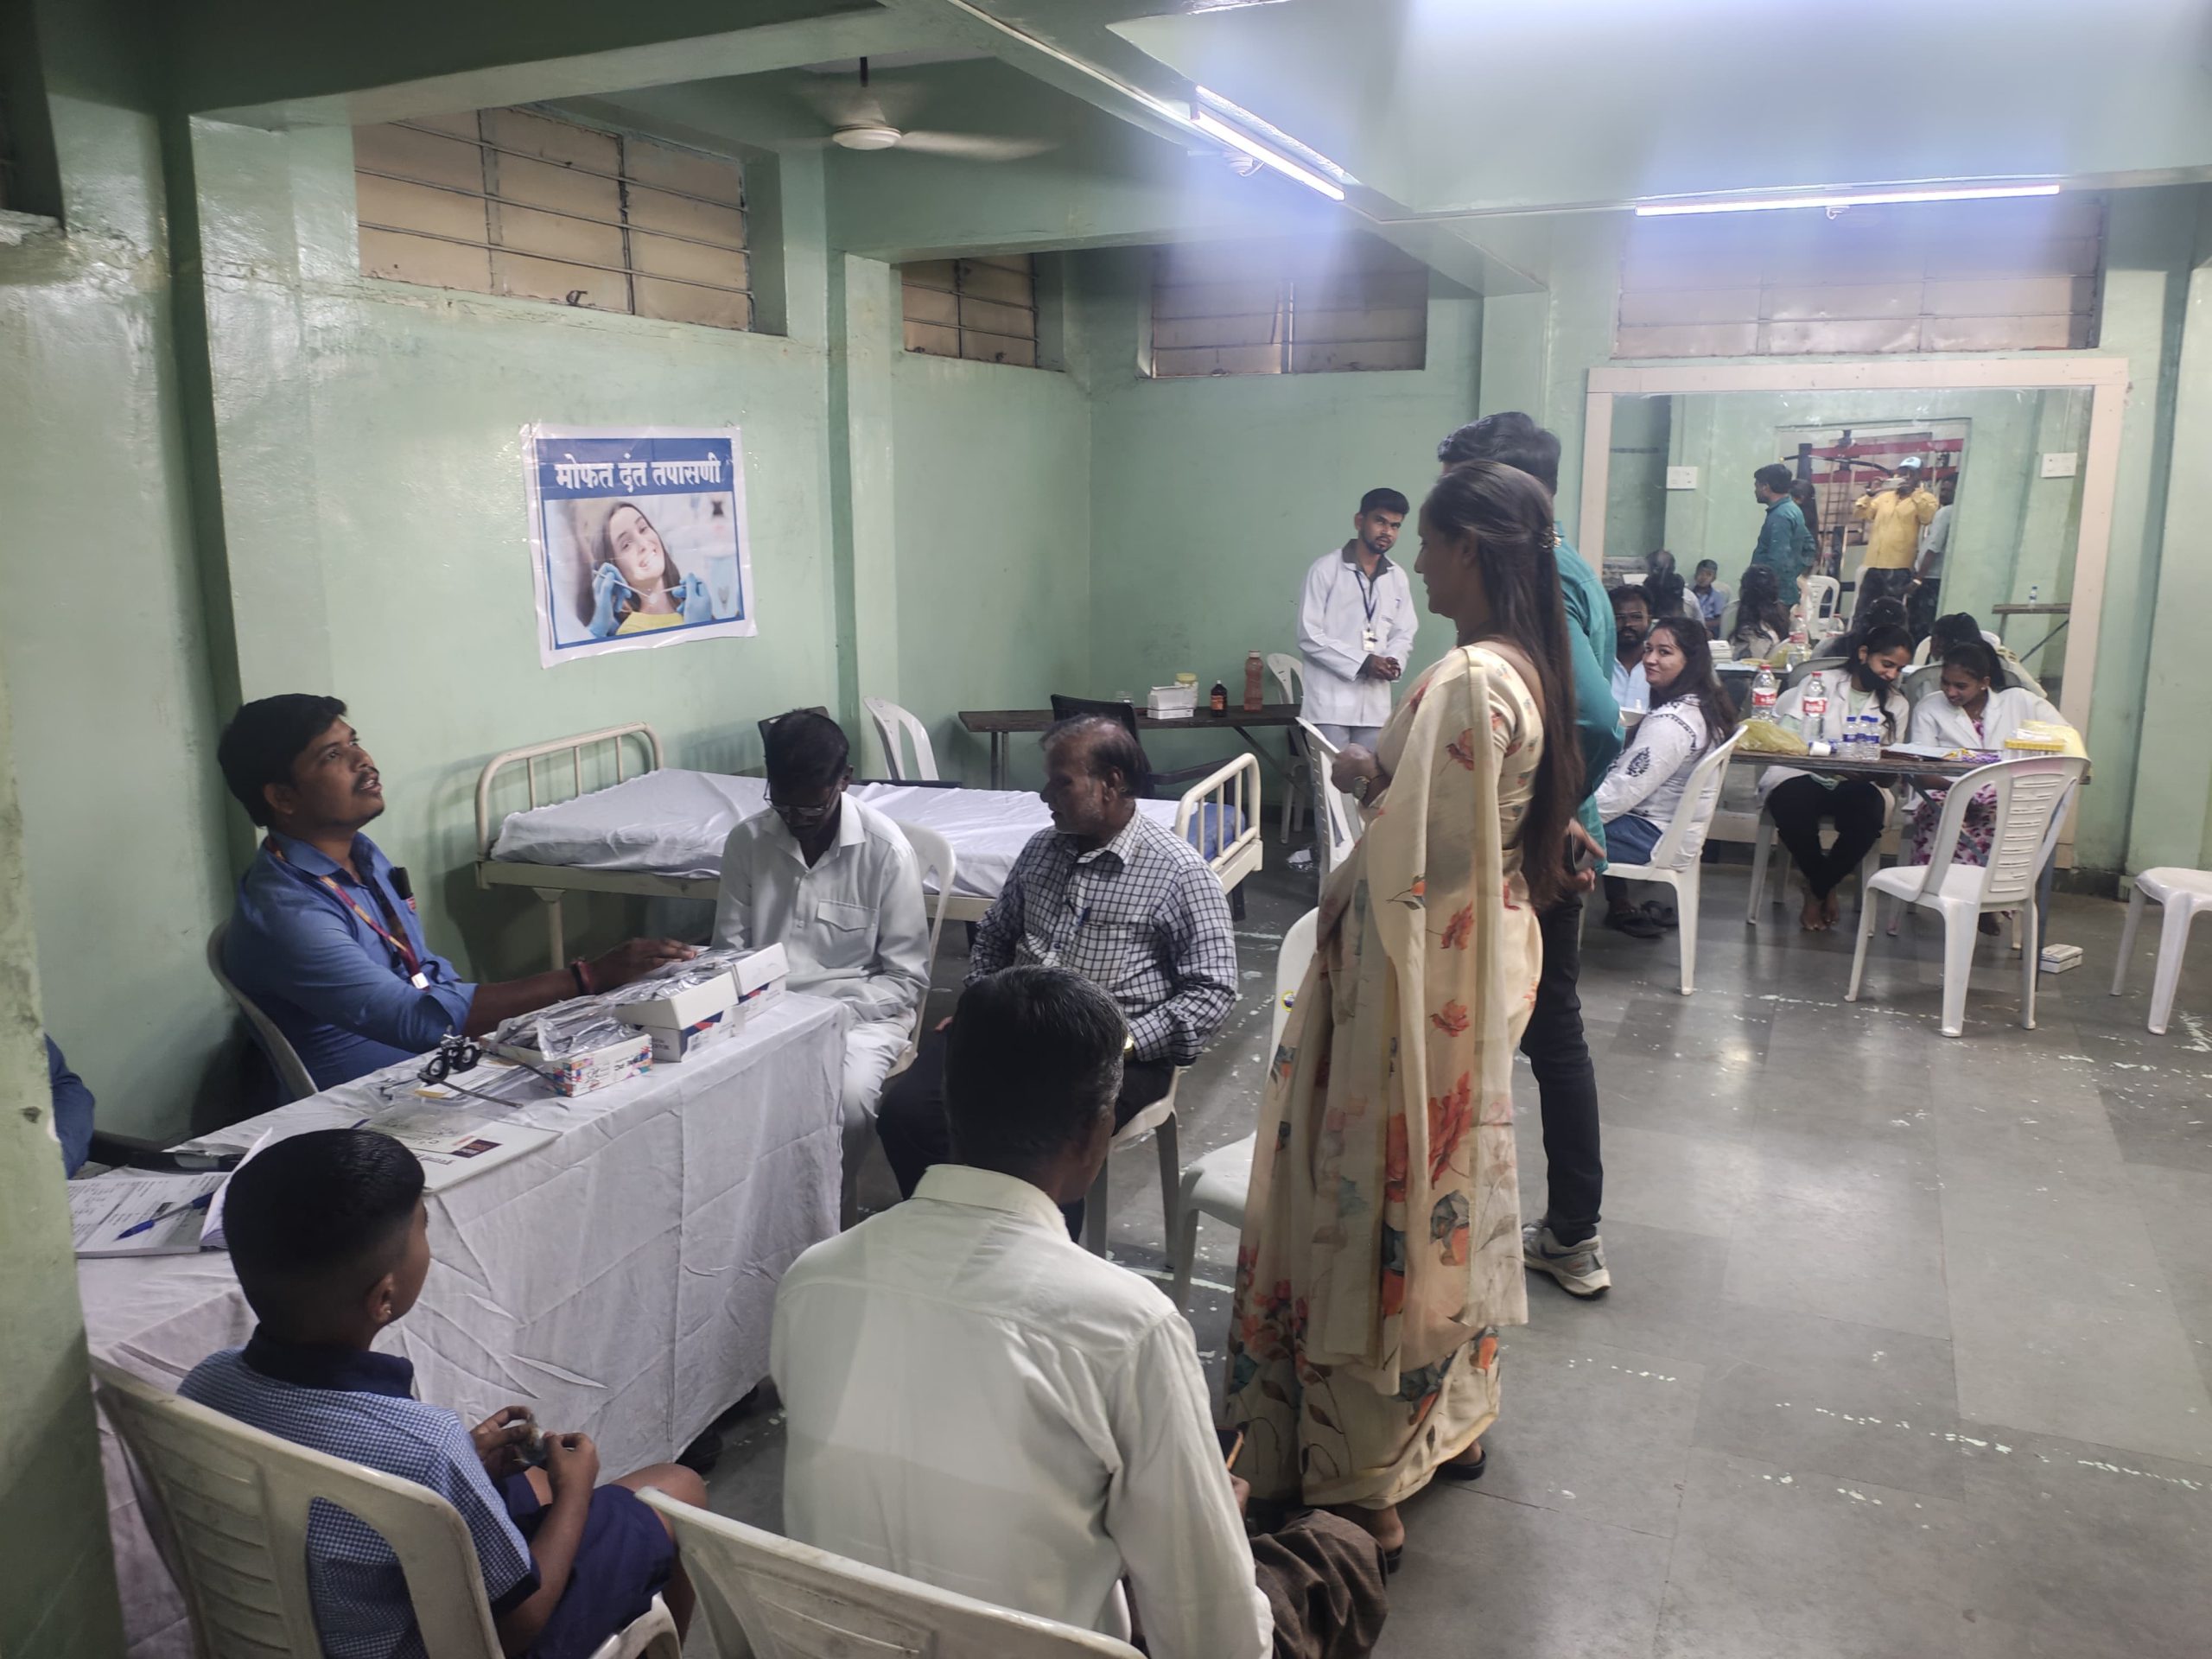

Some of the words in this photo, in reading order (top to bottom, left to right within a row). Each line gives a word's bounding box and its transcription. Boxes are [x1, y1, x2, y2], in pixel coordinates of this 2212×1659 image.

[555, 454, 614, 489] मोफत
[618, 453, 647, 493] दंत
[651, 452, 721, 486] तपासणी
